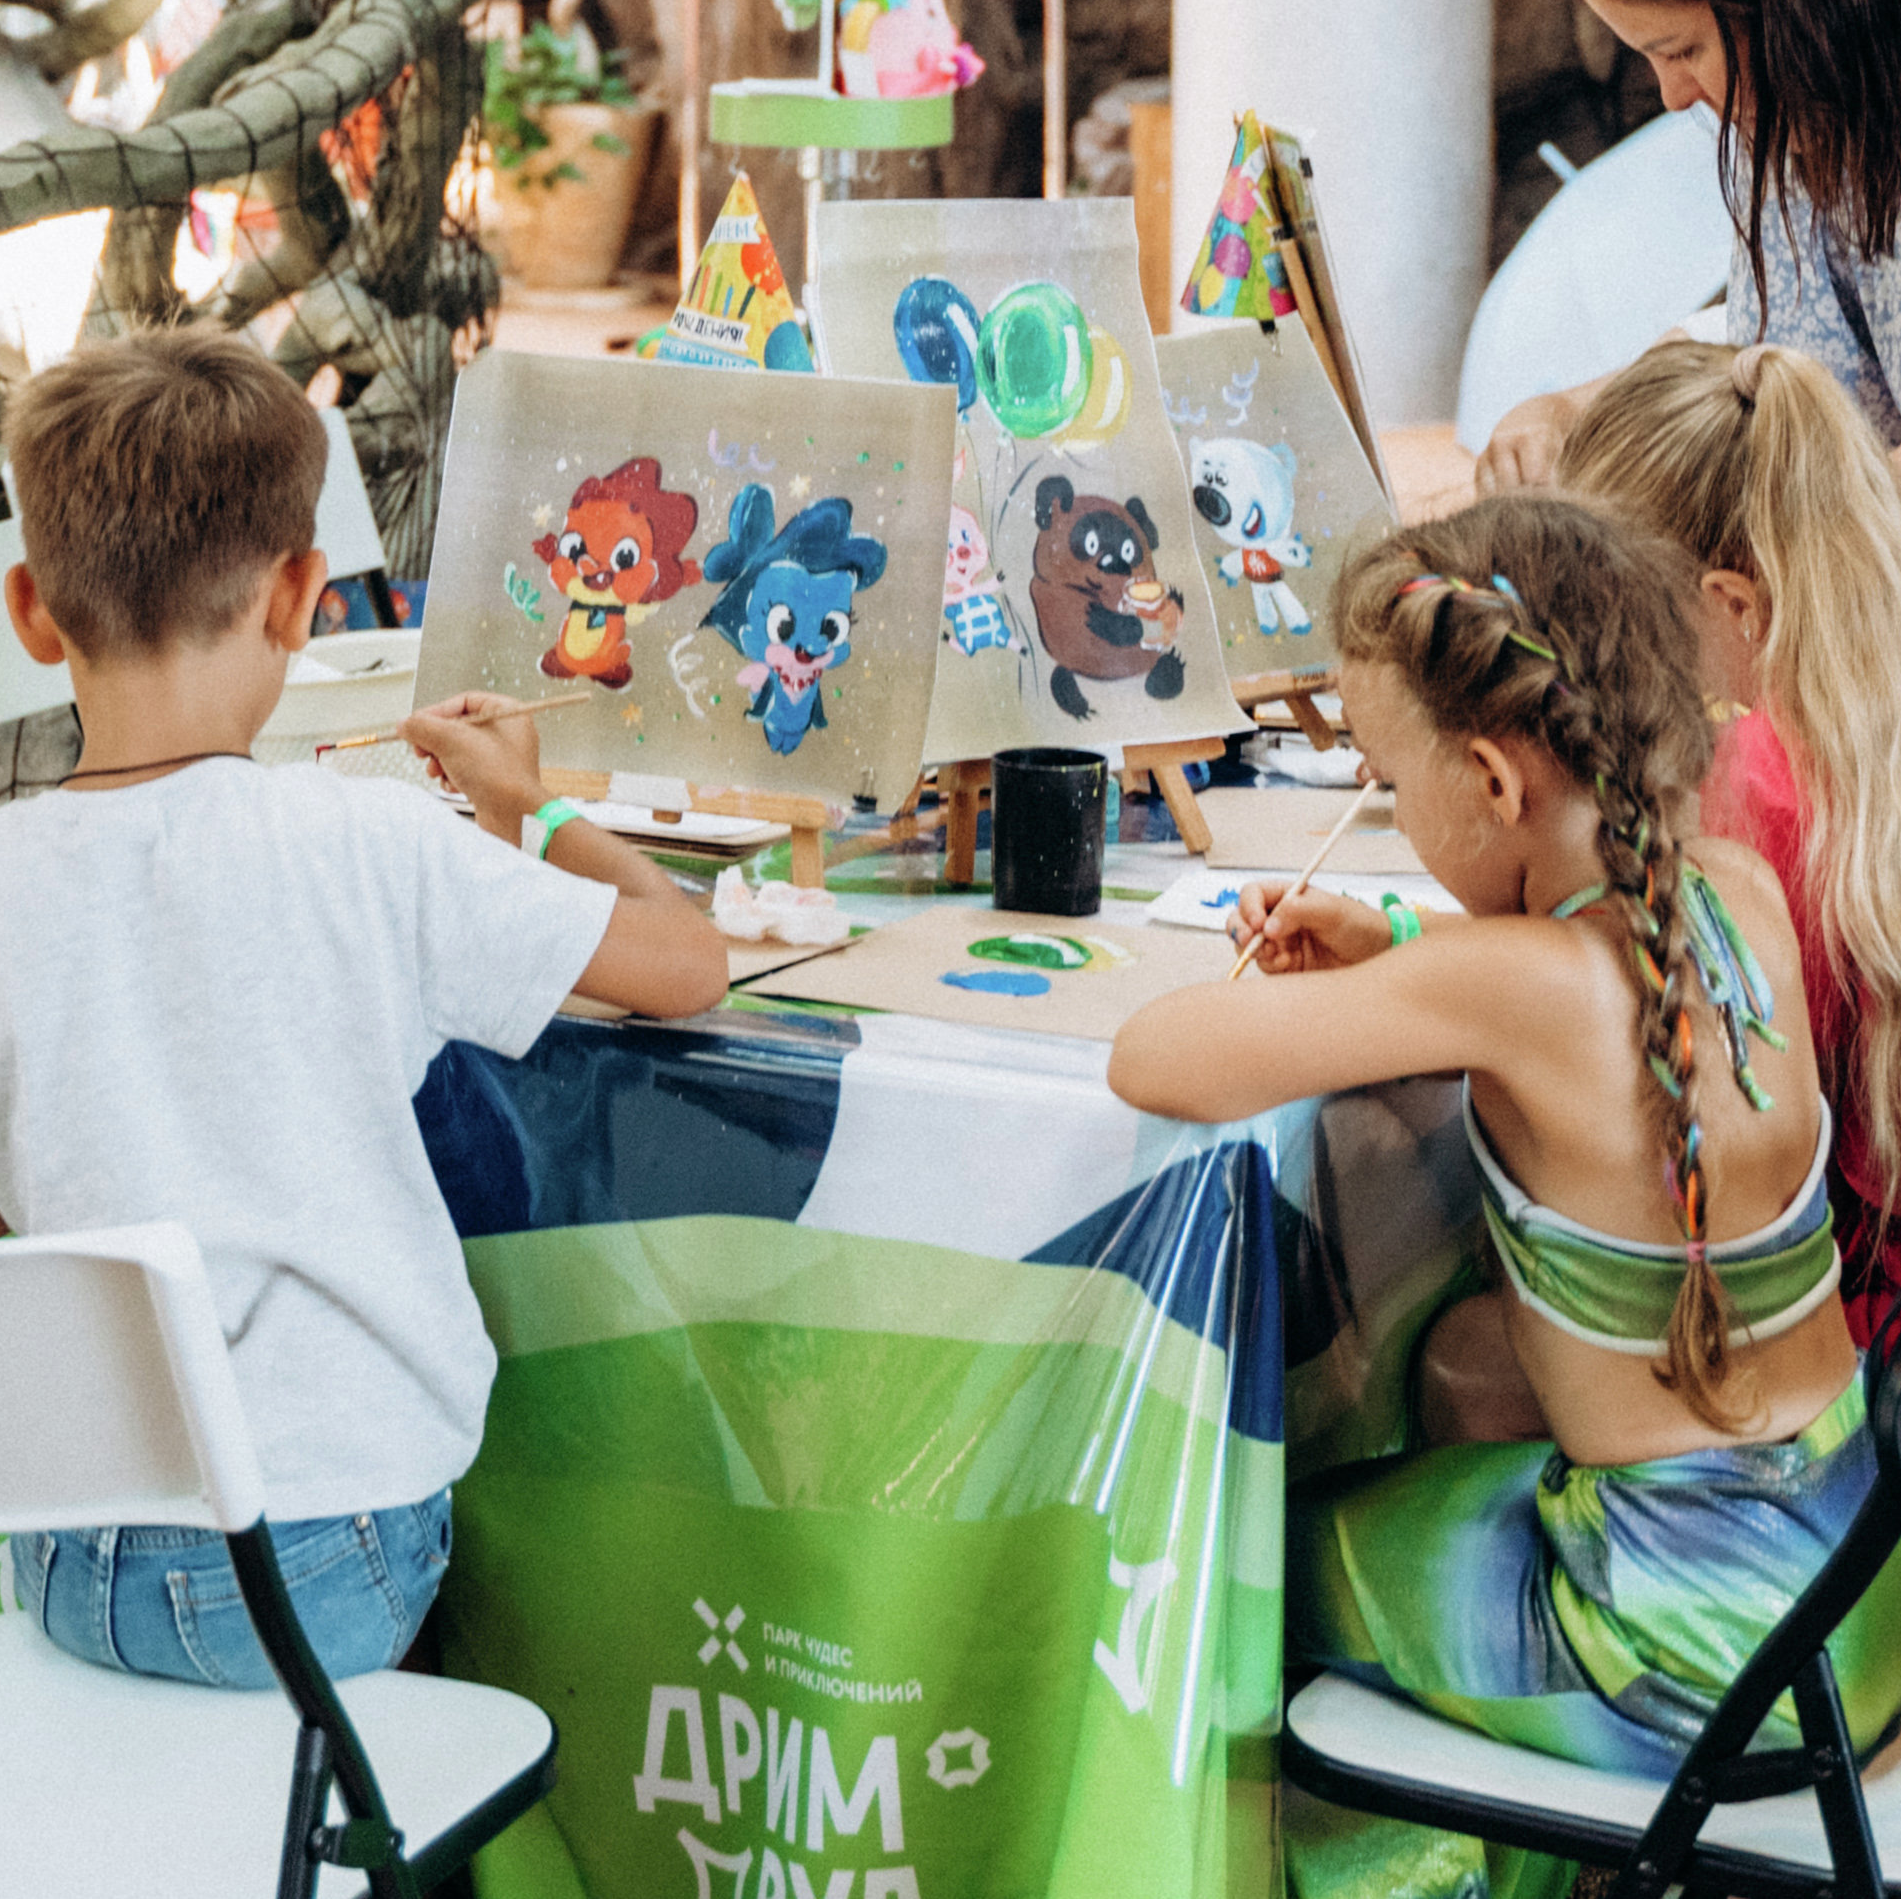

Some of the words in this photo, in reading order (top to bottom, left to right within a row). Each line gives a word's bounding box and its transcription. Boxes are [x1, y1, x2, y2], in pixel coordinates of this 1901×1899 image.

[763, 1621, 802, 1651] ПАРК
[805, 1634, 853, 1669] ЧУДЕС
[764, 1654, 777, 1674] И
[780, 1657, 924, 1704] ПРИКЛЮЧЕНИЙ
[633, 1684, 905, 1853] ДРИМ
